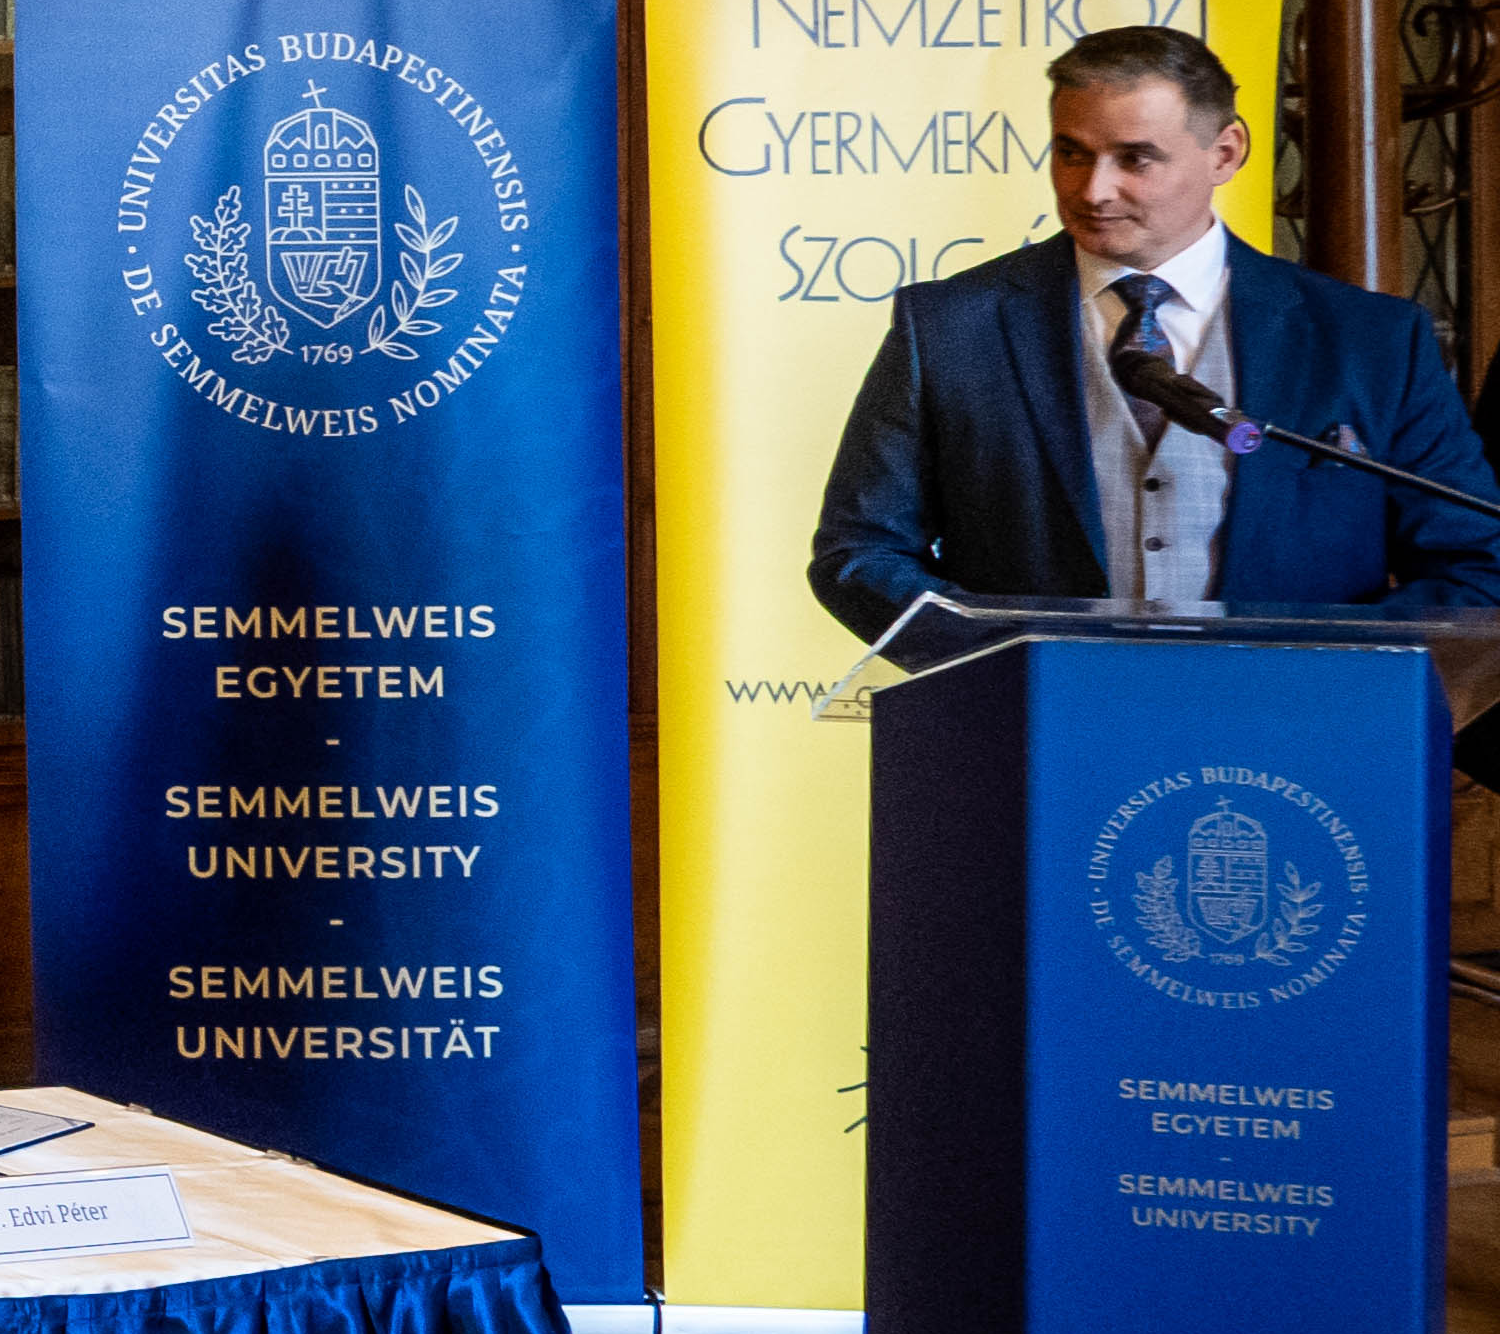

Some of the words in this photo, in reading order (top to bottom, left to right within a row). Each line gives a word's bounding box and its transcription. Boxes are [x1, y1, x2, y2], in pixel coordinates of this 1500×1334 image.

[118, 44, 266, 232] UNIVERSITAS
[280, 32, 529, 232] BUDAPESTINENSIS
[123, 267, 161, 317] DE
[150, 324, 378, 437] SEMMELWEIS
[393, 265, 528, 424] NOMINATA
[300, 344, 353, 365] 1769
[162, 605, 496, 640] SEMMELWEIS
[215, 667, 444, 699] EGYETEM
[165, 785, 500, 819] SEMMELWEIS
[1088, 771, 1192, 881] UNIVERSITAS
[1201, 766, 1370, 893] BUDAPESTINENSIS
[188, 846, 482, 880] UNIVERSITY
[1090, 899, 1115, 929] DE
[1107, 935, 1261, 1009] SEMMELWEIS
[1269, 910, 1368, 1004] NOMINATA
[168, 965, 504, 1000] SEMMELWEIS
[176, 1020, 500, 1060] UNIVERSITÄT
[1118, 1077, 1335, 1110] SEMMELWEIS
[1151, 1113, 1301, 1140] EGYETEM
[1118, 1174, 1333, 1206] SEMMELWEIS
[10, 1205, 52, 1228] Edvi
[58, 1201, 109, 1224] Péter
[1131, 1208, 1323, 1239] UNIVERSITY
